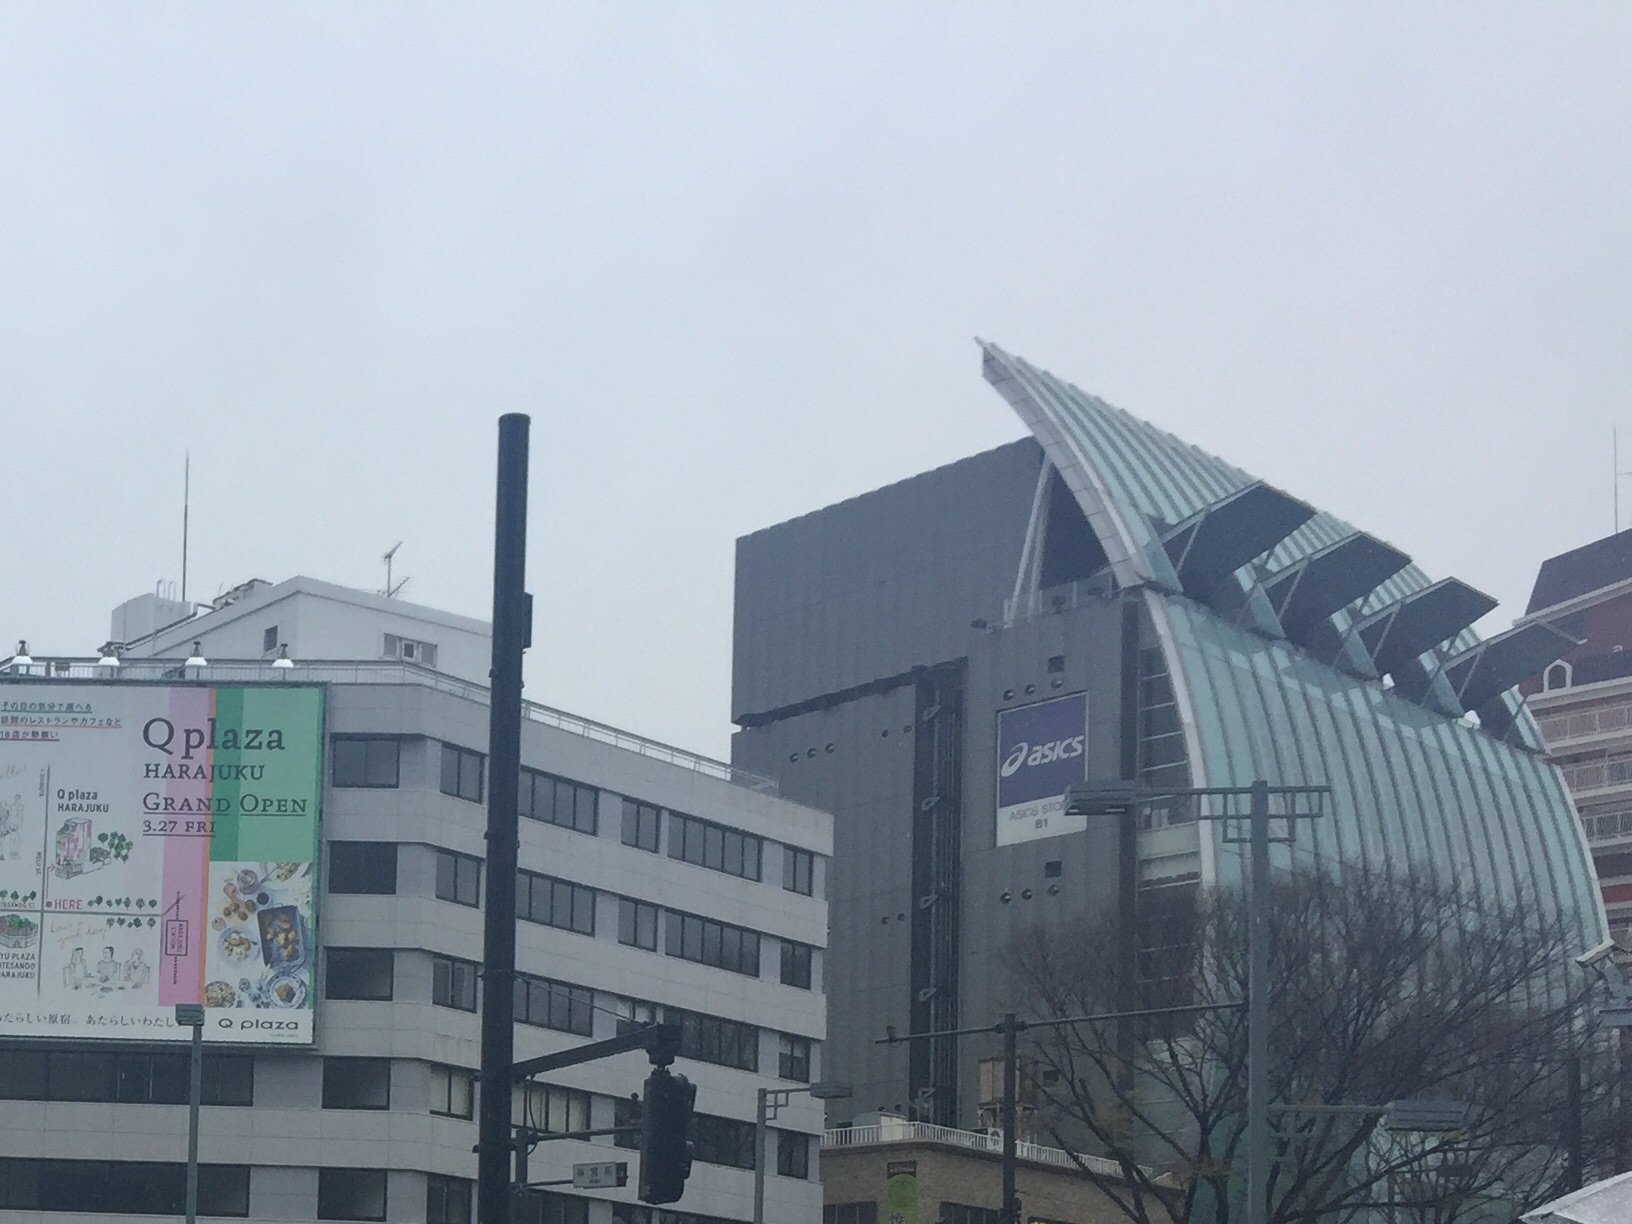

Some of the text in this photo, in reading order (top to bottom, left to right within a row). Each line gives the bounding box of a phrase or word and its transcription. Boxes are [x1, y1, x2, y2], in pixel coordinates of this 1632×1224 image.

[142, 717, 286, 761] Q plaza
[143, 763, 266, 783] HARAJUKU
[57, 788, 98, 802] Q plaza
[57, 803, 109, 813] HARAJUKU
[142, 820, 216, 834] 3.27 FRI
[1035, 817, 1048, 830] B1
[54, 899, 83, 910] HERE
[11, 952, 36, 961] PLAZA
[218, 1017, 299, 1031] Q plaza
